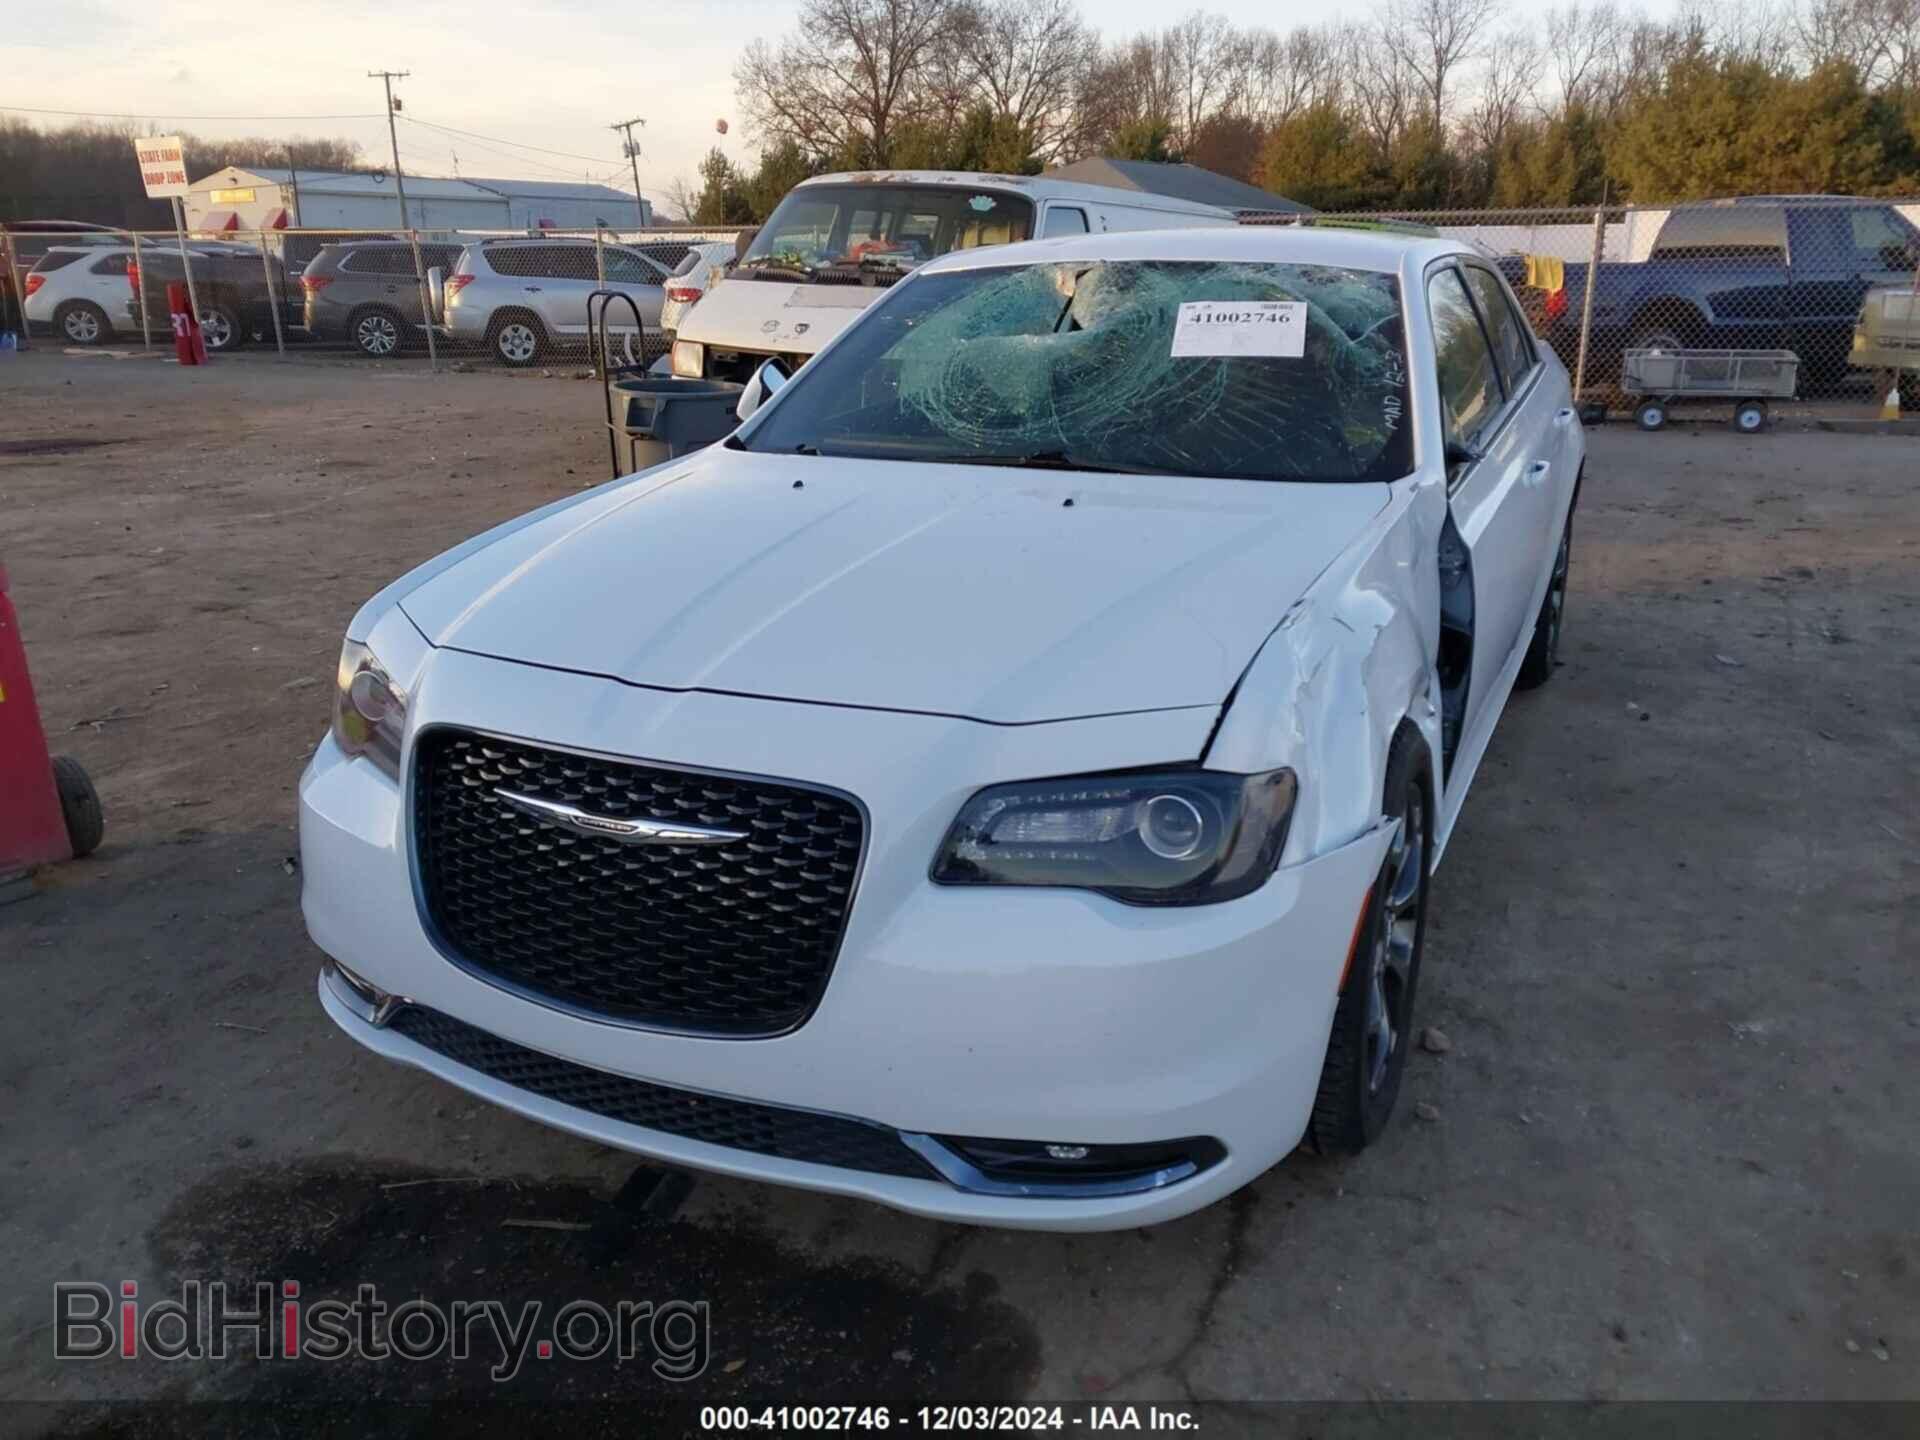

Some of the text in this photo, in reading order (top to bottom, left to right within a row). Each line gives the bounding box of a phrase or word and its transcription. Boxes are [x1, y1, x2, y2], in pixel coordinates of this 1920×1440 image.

[139, 148, 181, 164] STATE FARM
[144, 170, 186, 187] DROP ZONE
[1189, 311, 1291, 324] 41002746
